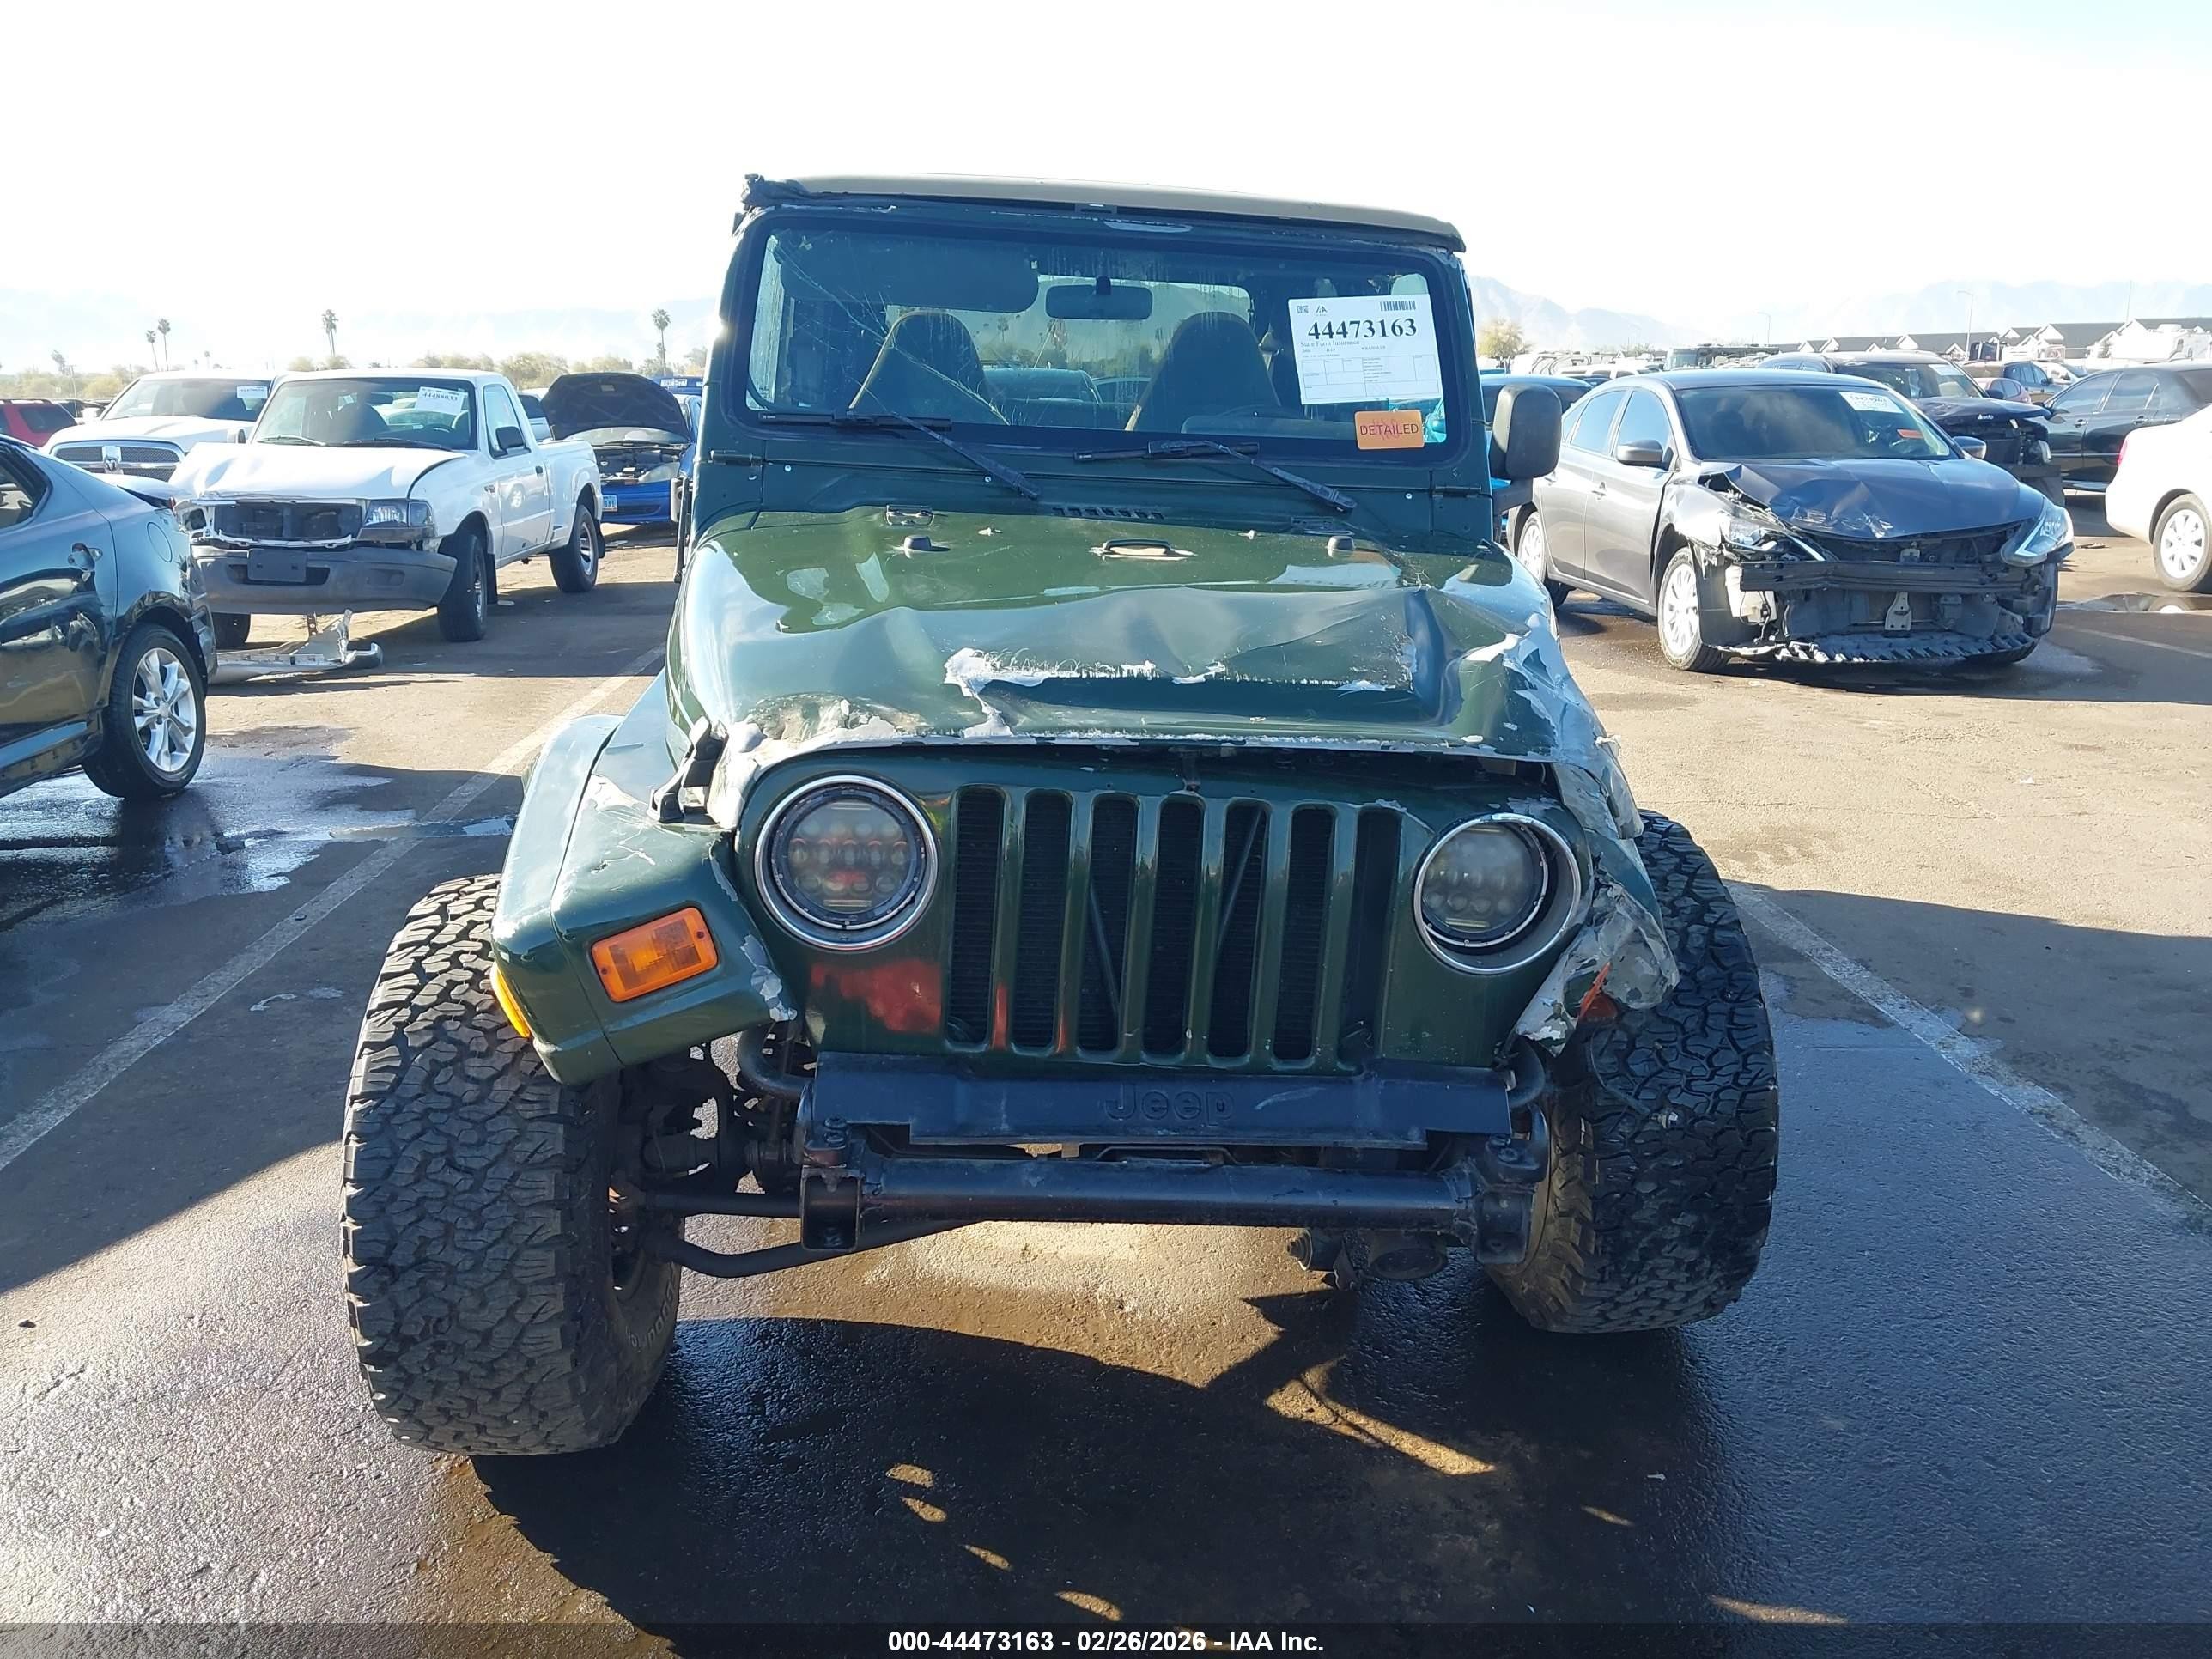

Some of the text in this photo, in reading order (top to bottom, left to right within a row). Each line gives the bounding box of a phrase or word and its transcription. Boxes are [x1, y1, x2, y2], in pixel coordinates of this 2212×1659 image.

[1308, 318, 1417, 340] 44473163
[1359, 423, 1419, 435] DETAILED
[1104, 1083, 1234, 1127] Jeep
